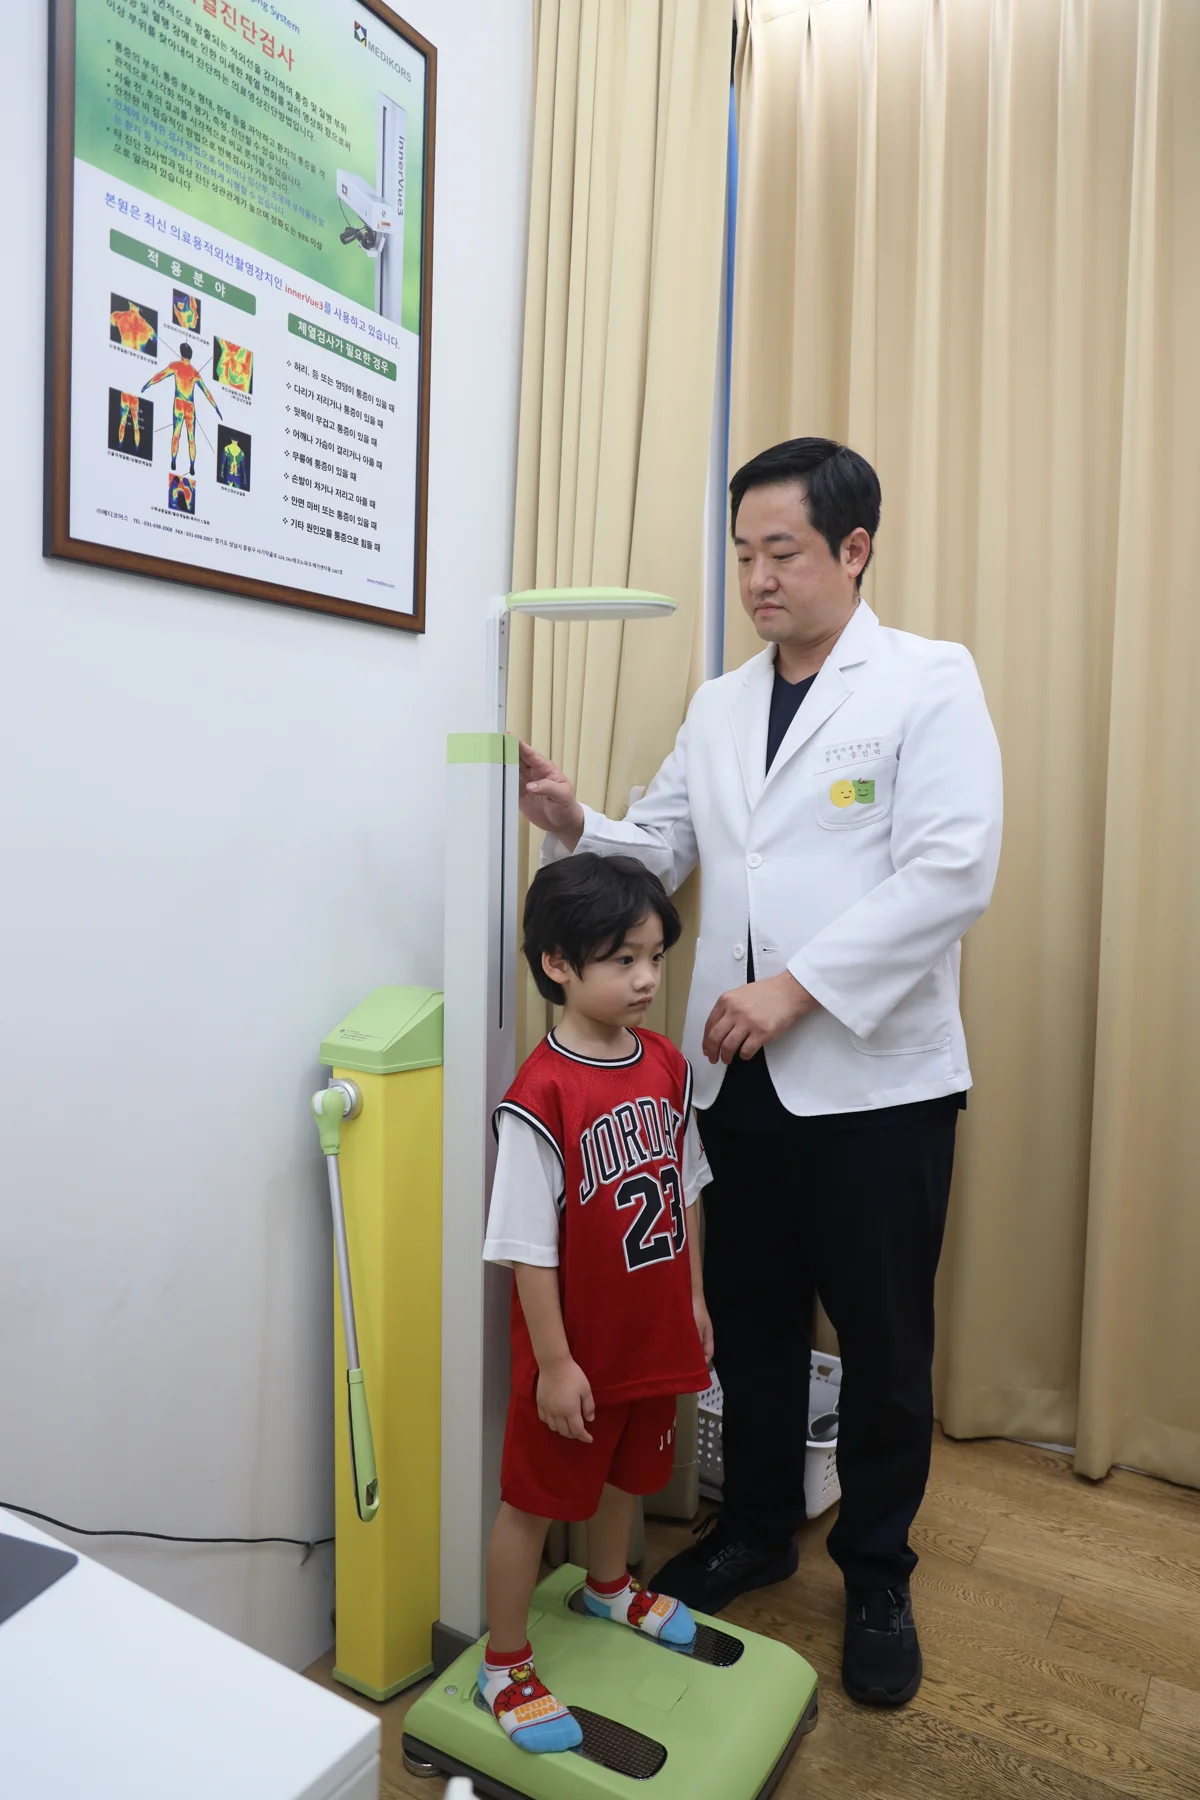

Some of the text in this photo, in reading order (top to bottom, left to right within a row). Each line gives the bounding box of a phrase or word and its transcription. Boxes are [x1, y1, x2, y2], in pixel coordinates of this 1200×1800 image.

[190, 0, 294, 74] 열진단검사
[270, 4, 299, 37] System
[367, 41, 412, 83] MEDIKORS
[397, 135, 406, 217] innerVue3
[104, 190, 400, 350] 본원은 최신 의료용적외선촬영장치인 innerVue3를 사용하고 있습니다.
[297, 320, 389, 374] 체열검사가 필요한 경우
[293, 361, 394, 413] 허리, 등 또는 엉덩이 통증이 있을 때
[293, 384, 383, 428] 다리가 저리거나 통증이 있을 때
[292, 406, 377, 447] 뒷목이 무겁고 통증이 있을 때
[291, 451, 356, 481] 무릎에 통증이 있을 때
[292, 429, 382, 470] 어깨나 가슴이 결리거나 아플 때
[291, 473, 376, 509] 손발이 차거나 저리고 아플 때
[290, 496, 377, 530] 안면 마비 또는 통증이 있을 때
[290, 518, 380, 552] 기타 원인모를 통증으로 힘들 때
[614, 1163, 687, 1273] 23
[513, 1695, 553, 1716] IRON
[515, 1704, 557, 1724] MAN
